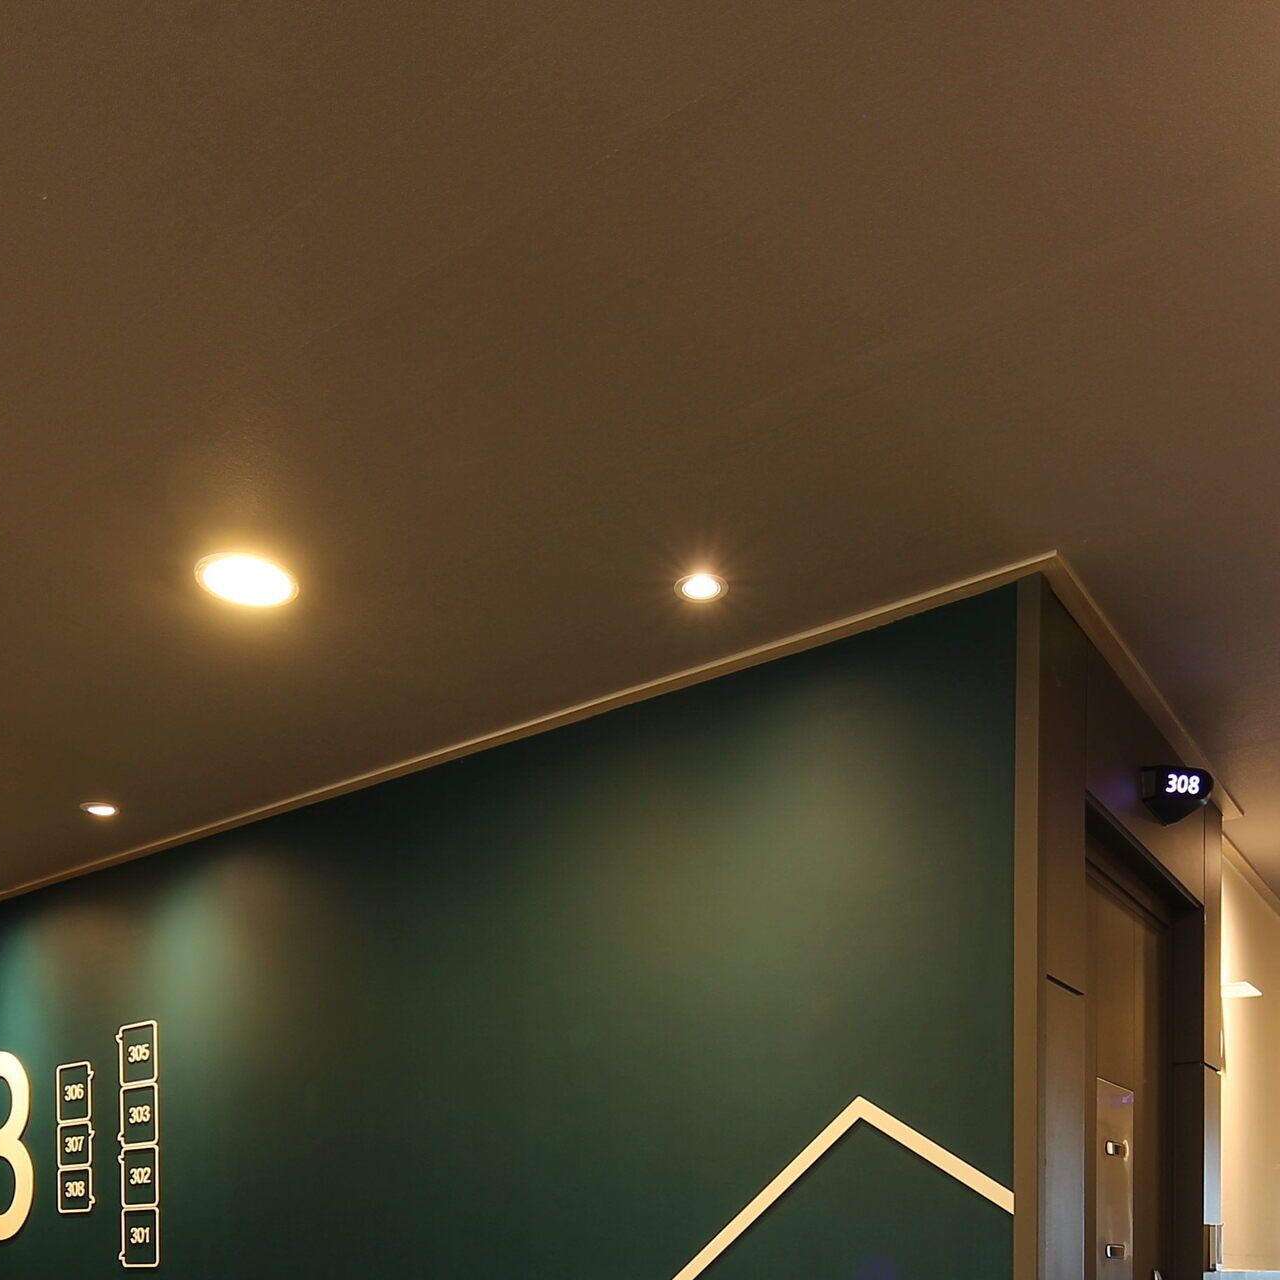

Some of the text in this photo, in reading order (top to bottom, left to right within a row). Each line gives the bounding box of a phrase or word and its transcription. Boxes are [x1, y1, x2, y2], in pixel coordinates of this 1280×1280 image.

[1165, 773, 1201, 795] 308
[128, 1043, 150, 1063] 305
[64, 1083, 84, 1102] 306
[128, 1105, 151, 1124] 303
[64, 1135, 85, 1153] 307
[129, 1166, 152, 1185] 302
[65, 1180, 85, 1198] 308
[130, 1226, 150, 1244] 301
